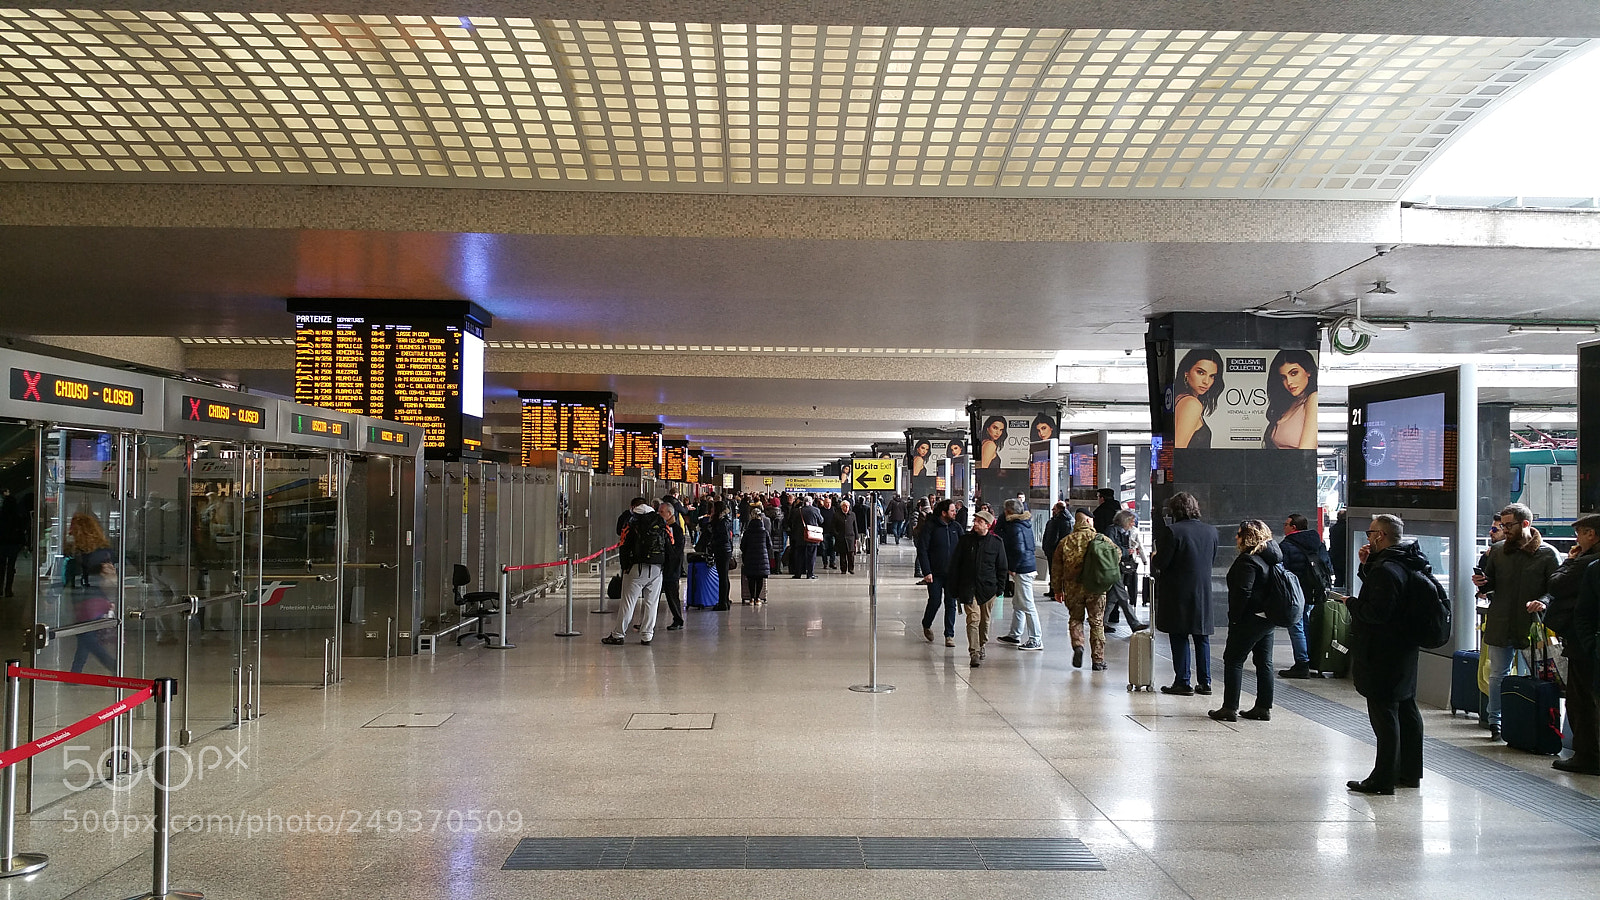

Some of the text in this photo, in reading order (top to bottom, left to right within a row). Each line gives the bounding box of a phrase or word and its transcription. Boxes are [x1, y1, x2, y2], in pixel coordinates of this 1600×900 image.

[296, 315, 332, 323] PARTENZE
[55, 380, 88, 400] CHIUSO
[103, 387, 134, 406] CLOSED
[1226, 388, 1267, 406] OVS
[208, 404, 230, 420] CHIUSO
[238, 409, 259, 424] CLOSED
[1352, 408, 1361, 425] 21
[332, 423, 342, 435] EXIT
[1009, 436, 1030, 446] OVS
